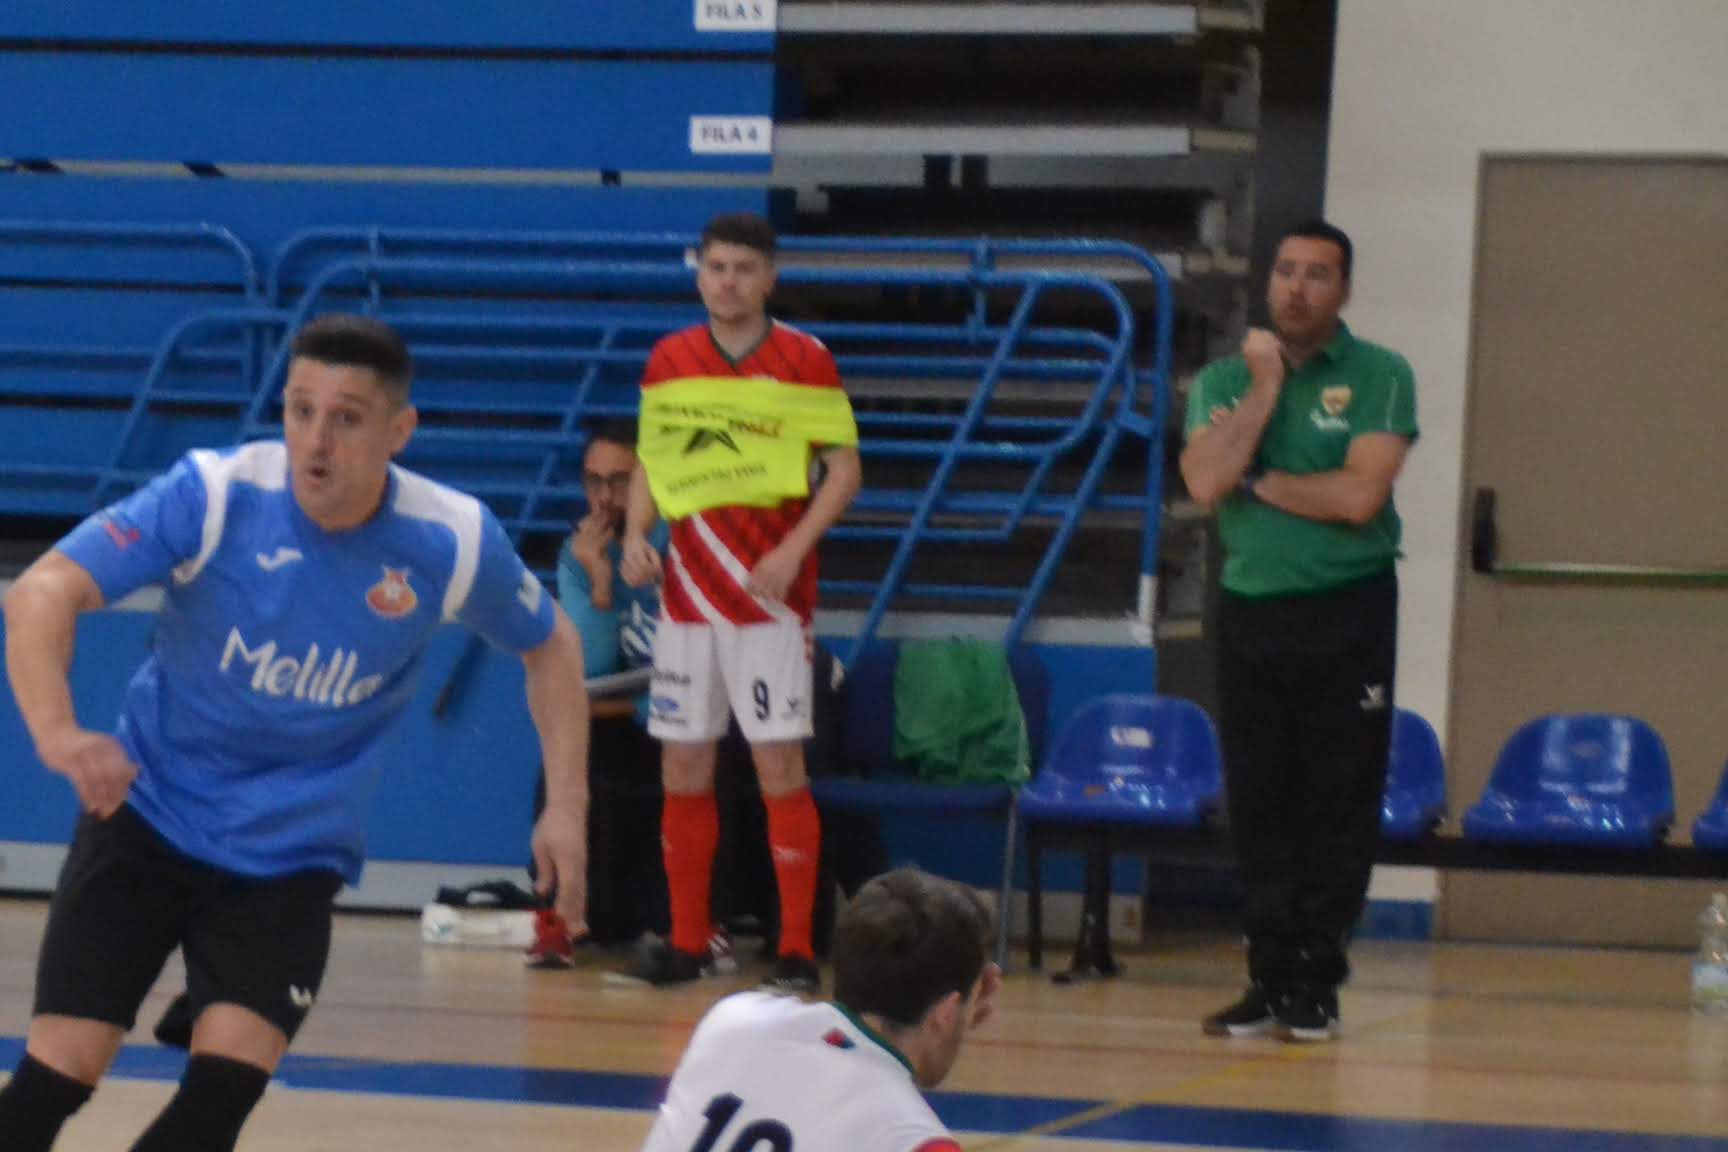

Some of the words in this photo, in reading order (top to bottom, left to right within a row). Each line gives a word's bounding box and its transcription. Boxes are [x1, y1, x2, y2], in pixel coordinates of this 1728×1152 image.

[704, 4, 747, 20] FILA
[700, 126, 743, 143] FILA
[752, 677, 770, 722] 9
